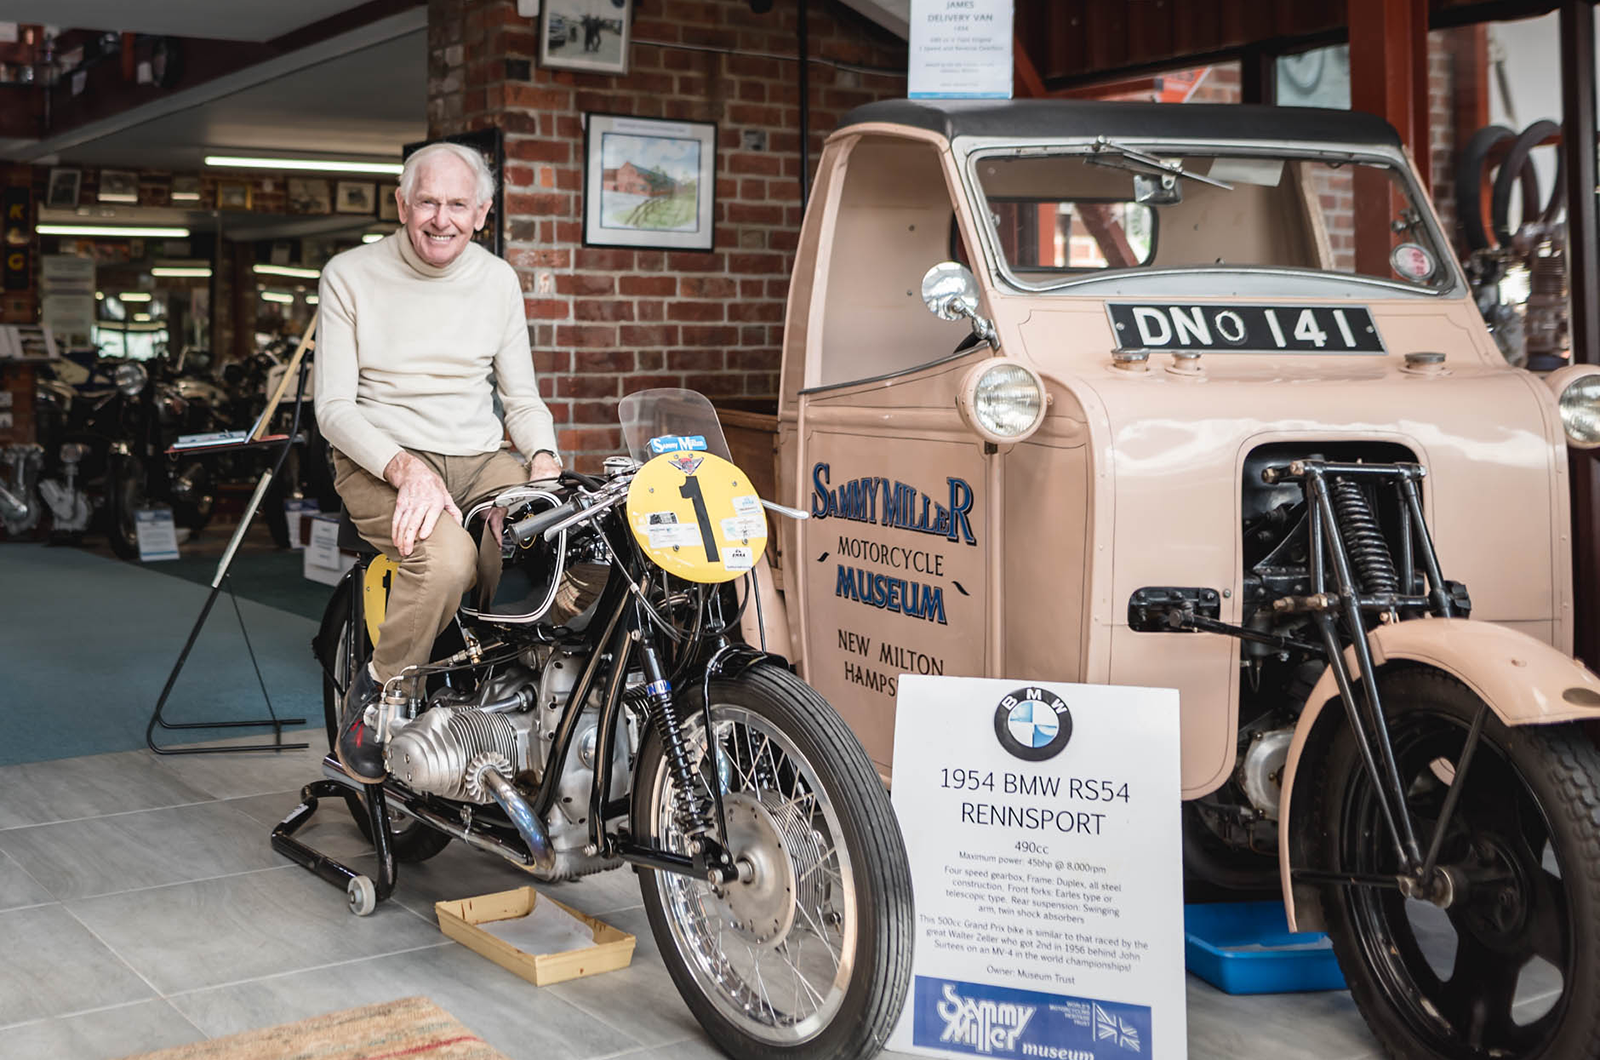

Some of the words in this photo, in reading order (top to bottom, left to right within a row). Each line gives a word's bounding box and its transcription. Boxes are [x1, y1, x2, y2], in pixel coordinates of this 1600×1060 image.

[927, 14, 970, 22] DELIVERY
[973, 14, 993, 22] VAN
[947, 1, 974, 9] JAMES
[1264, 308, 1357, 348] 141
[679, 476, 720, 563] 1
[812, 462, 880, 524] SAMMY
[881, 477, 978, 546] MILLER
[837, 536, 944, 577] MOTORCYCLE
[835, 564, 948, 625] MUSEUM
[837, 629, 870, 657] NEW
[879, 642, 944, 676] MILTON
[844, 661, 899, 697] HAMPS
[1001, 688, 1068, 714] BMW
[940, 768, 995, 792] 1954
[1004, 773, 1060, 797] BMW
[1069, 778, 1131, 803] RS54
[961, 802, 1106, 836] RENNSPORT
[959, 851, 996, 863] Maximum
[1027, 858, 1053, 869] 45bhp
[1055, 860, 1065, 871] @
[1014, 841, 1050, 855] 490cc
[944, 866, 962, 876] Four
[964, 868, 989, 878] speed
[1027, 874, 1054, 886] Frame:
[1089, 880, 1100, 890] all
[1101, 882, 1122, 892] steel
[1007, 884, 1029, 894] Front
[1055, 889, 1081, 900] Earles
[1083, 893, 1101, 904] type
[1103, 895, 1113, 903] or
[945, 889, 986, 902] telescopic
[1011, 896, 1030, 906] Rear
[1083, 904, 1120, 918] Swinging
[978, 905, 996, 914] arm,
[998, 907, 1015, 916] twin
[1016, 908, 1042, 919] shock
[1043, 912, 1085, 925] absorbers
[919, 914, 936, 925] This
[938, 916, 961, 927] 500cc
[963, 919, 988, 930] Grand
[990, 922, 1005, 931] Prix
[1007, 925, 1024, 935] bike
[1026, 928, 1033, 936] is
[1036, 929, 1063, 940] similar
[1064, 932, 1074, 941] to
[1076, 933, 1093, 944] that
[1095, 936, 1119, 946] raced
[1121, 939, 1132, 950] by
[1134, 940, 1148, 950] the
[926, 928, 946, 938] great
[948, 929, 974, 941] Walter
[976, 933, 998, 944] Zeller
[1000, 936, 1018, 946] who
[1020, 939, 1034, 949] got
[1036, 940, 1052, 950] 2nd
[1054, 943, 1062, 951] in
[1065, 944, 1086, 954] 1956
[1087, 946, 1117, 958] behind
[1119, 950, 1141, 961] John
[934, 939, 965, 952] Surtees
[966, 945, 978, 953] on
[1015, 950, 1023, 959] in
[1025, 952, 1038, 960] the
[1041, 953, 1064, 964] world
[1066, 957, 1132, 973] championships!
[986, 964, 1015, 976] Owner:
[1017, 968, 1053, 981] Museum
[1055, 973, 1076, 985] Trust
[937, 983, 1038, 1028] Sammy
[1022, 1042, 1095, 1060] museum
